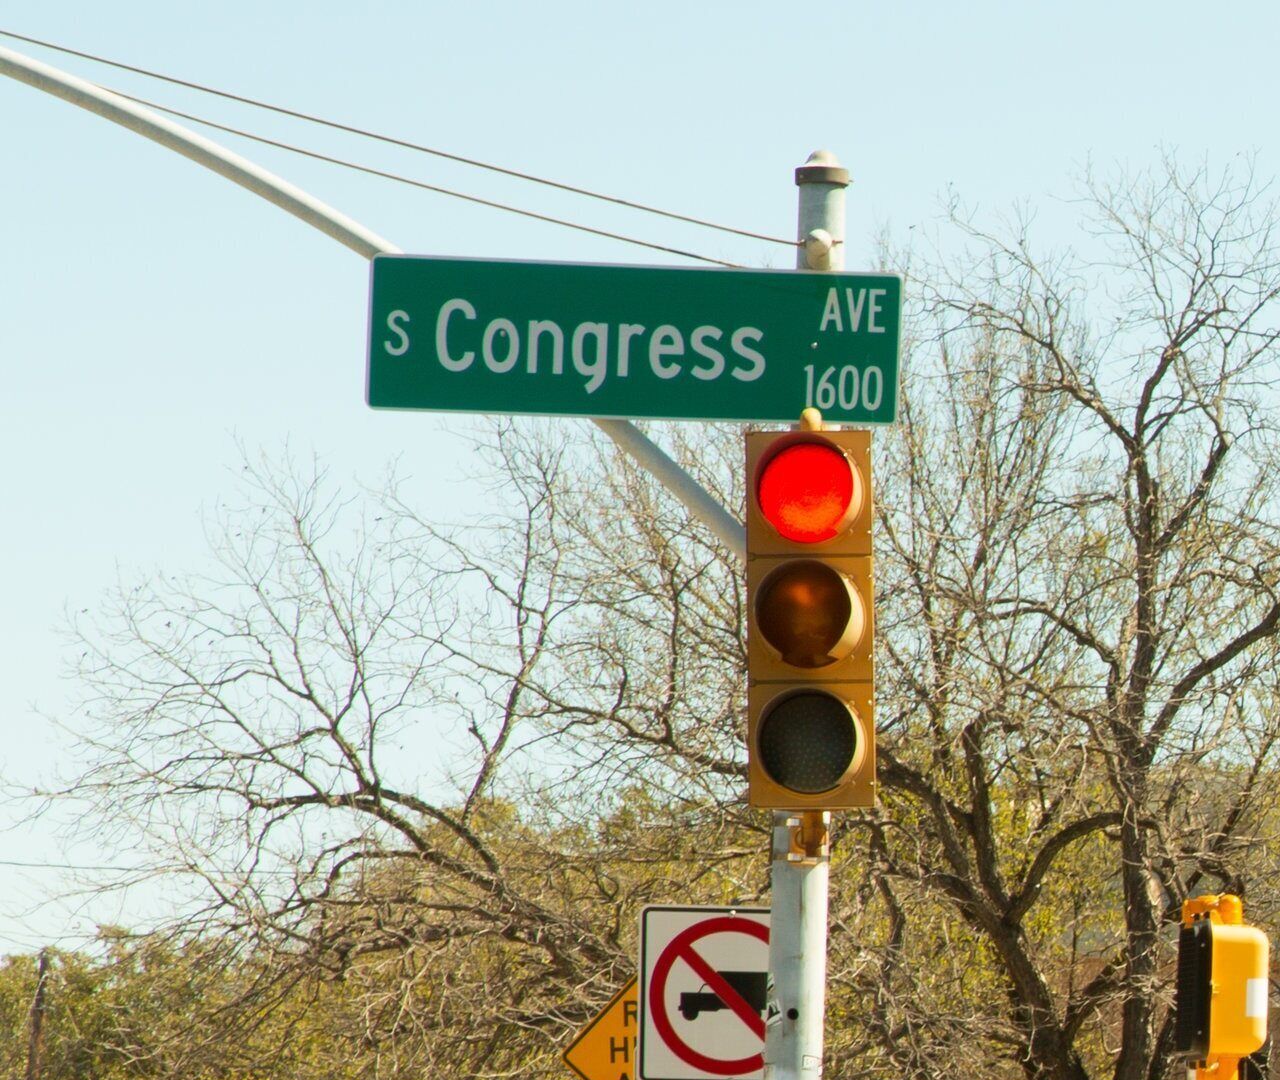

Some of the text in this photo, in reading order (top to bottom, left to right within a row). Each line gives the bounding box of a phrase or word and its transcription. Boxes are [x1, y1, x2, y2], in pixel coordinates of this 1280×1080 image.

[819, 287, 887, 334] AVE
[383, 298, 767, 395] S Congress
[803, 364, 884, 411] 1600
